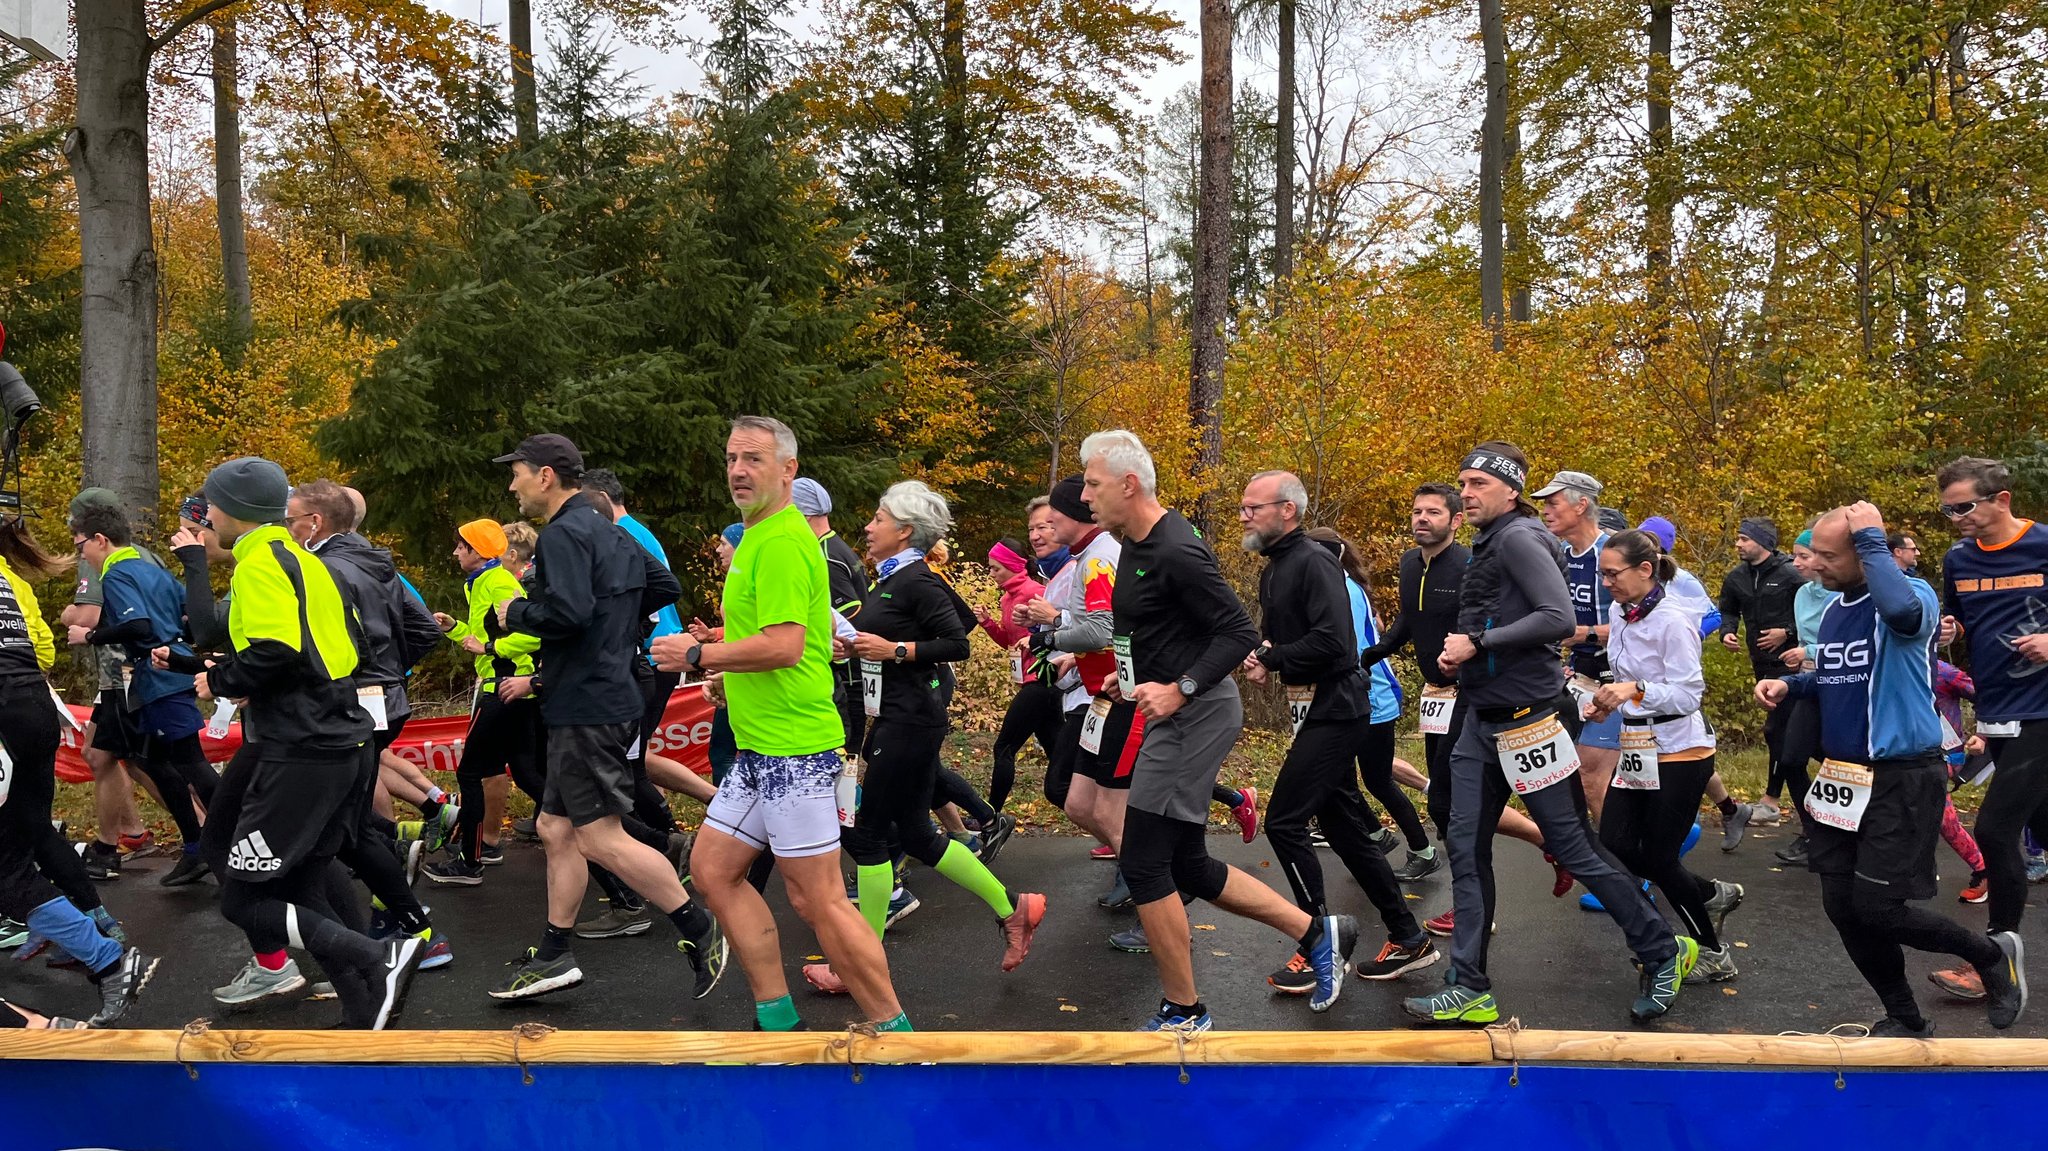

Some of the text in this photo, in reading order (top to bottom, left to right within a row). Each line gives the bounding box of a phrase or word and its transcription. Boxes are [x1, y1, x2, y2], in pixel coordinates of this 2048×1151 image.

[1493, 456, 1517, 474] SEE
[1814, 638, 1869, 670] TSG
[1420, 700, 1446, 718] 487
[1514, 740, 1558, 774] 367
[1527, 759, 1580, 790] Sparkasse
[1811, 781, 1854, 808] 499
[1811, 806, 1857, 829] Sparkasse
